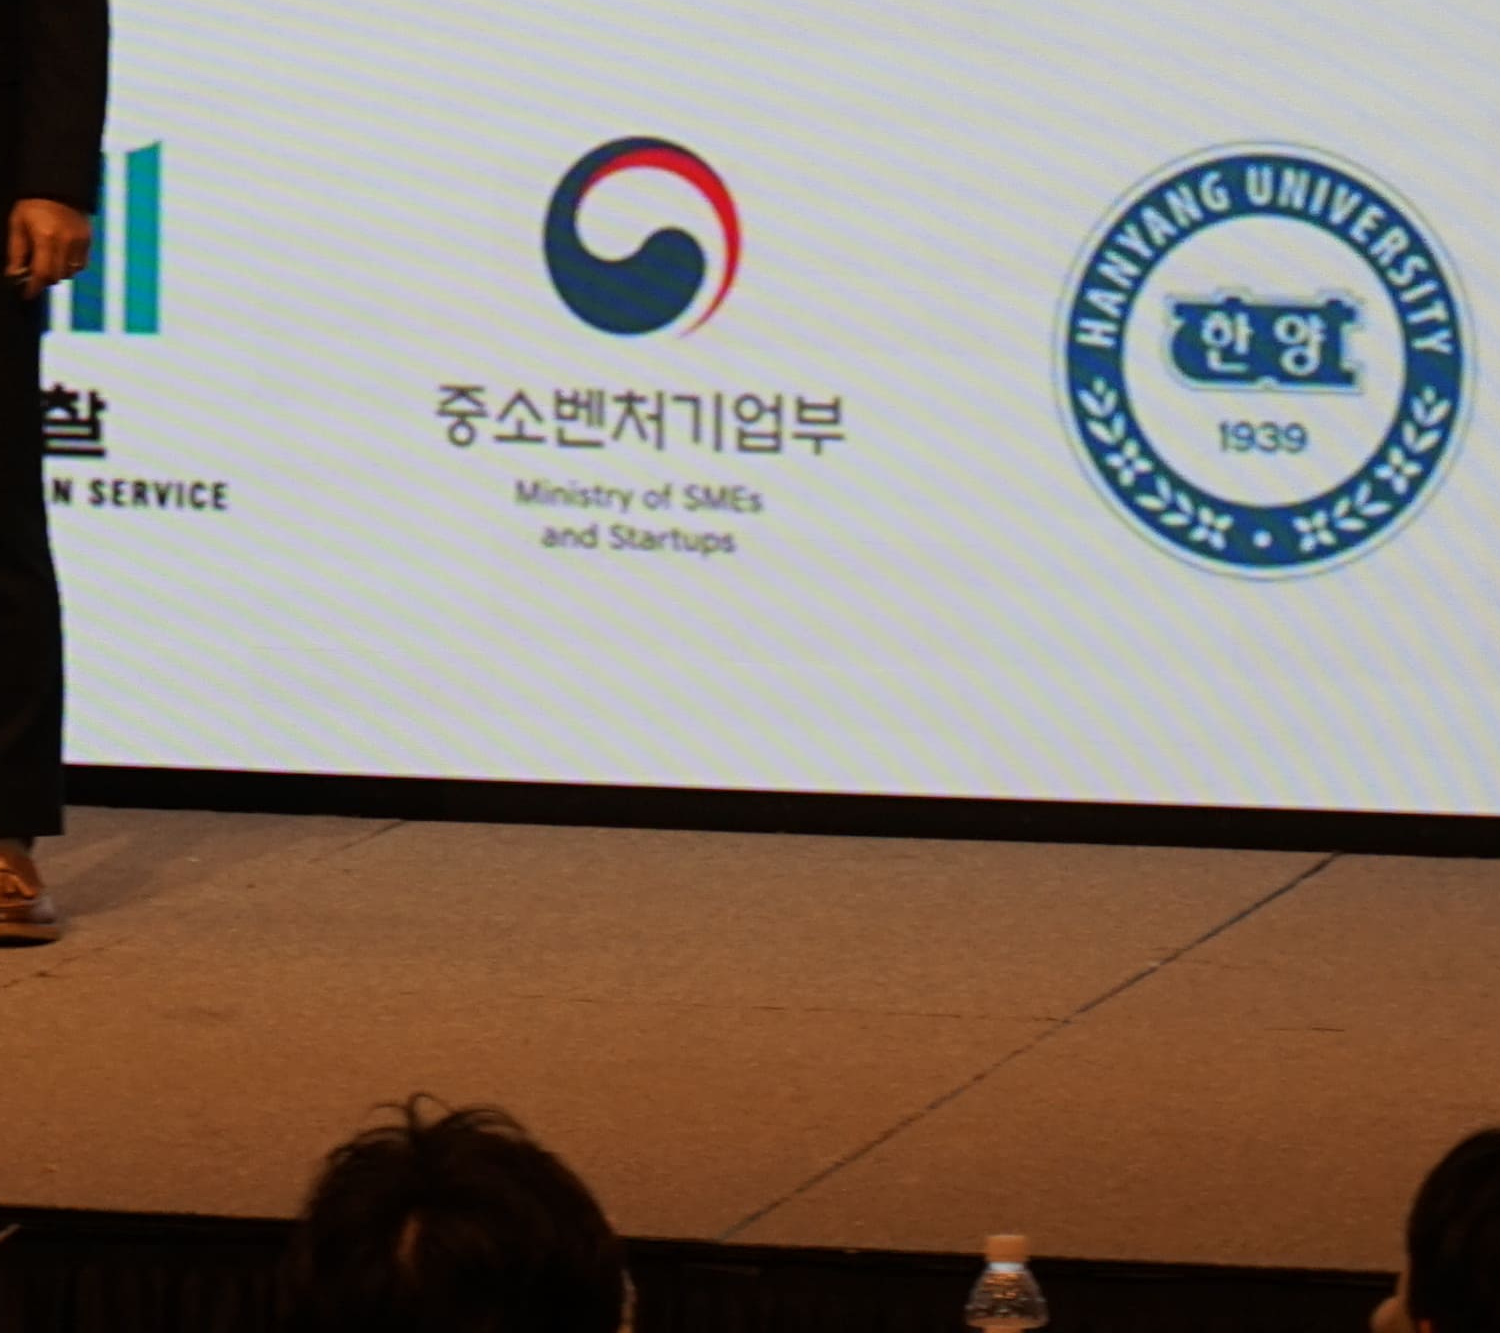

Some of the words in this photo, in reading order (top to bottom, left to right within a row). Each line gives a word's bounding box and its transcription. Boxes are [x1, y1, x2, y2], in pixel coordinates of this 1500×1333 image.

[1075, 170, 1230, 348] HANYANG
[1244, 163, 1455, 355] UNIVERSITY
[434, 383, 847, 456] 중소벤처기업부
[1218, 420, 1309, 455] 1939
[88, 477, 230, 511] SERVICE
[513, 478, 634, 514] Ministry
[641, 482, 674, 511] of
[682, 482, 765, 515] SMEs
[540, 523, 599, 550] and
[607, 522, 738, 558] Startups
